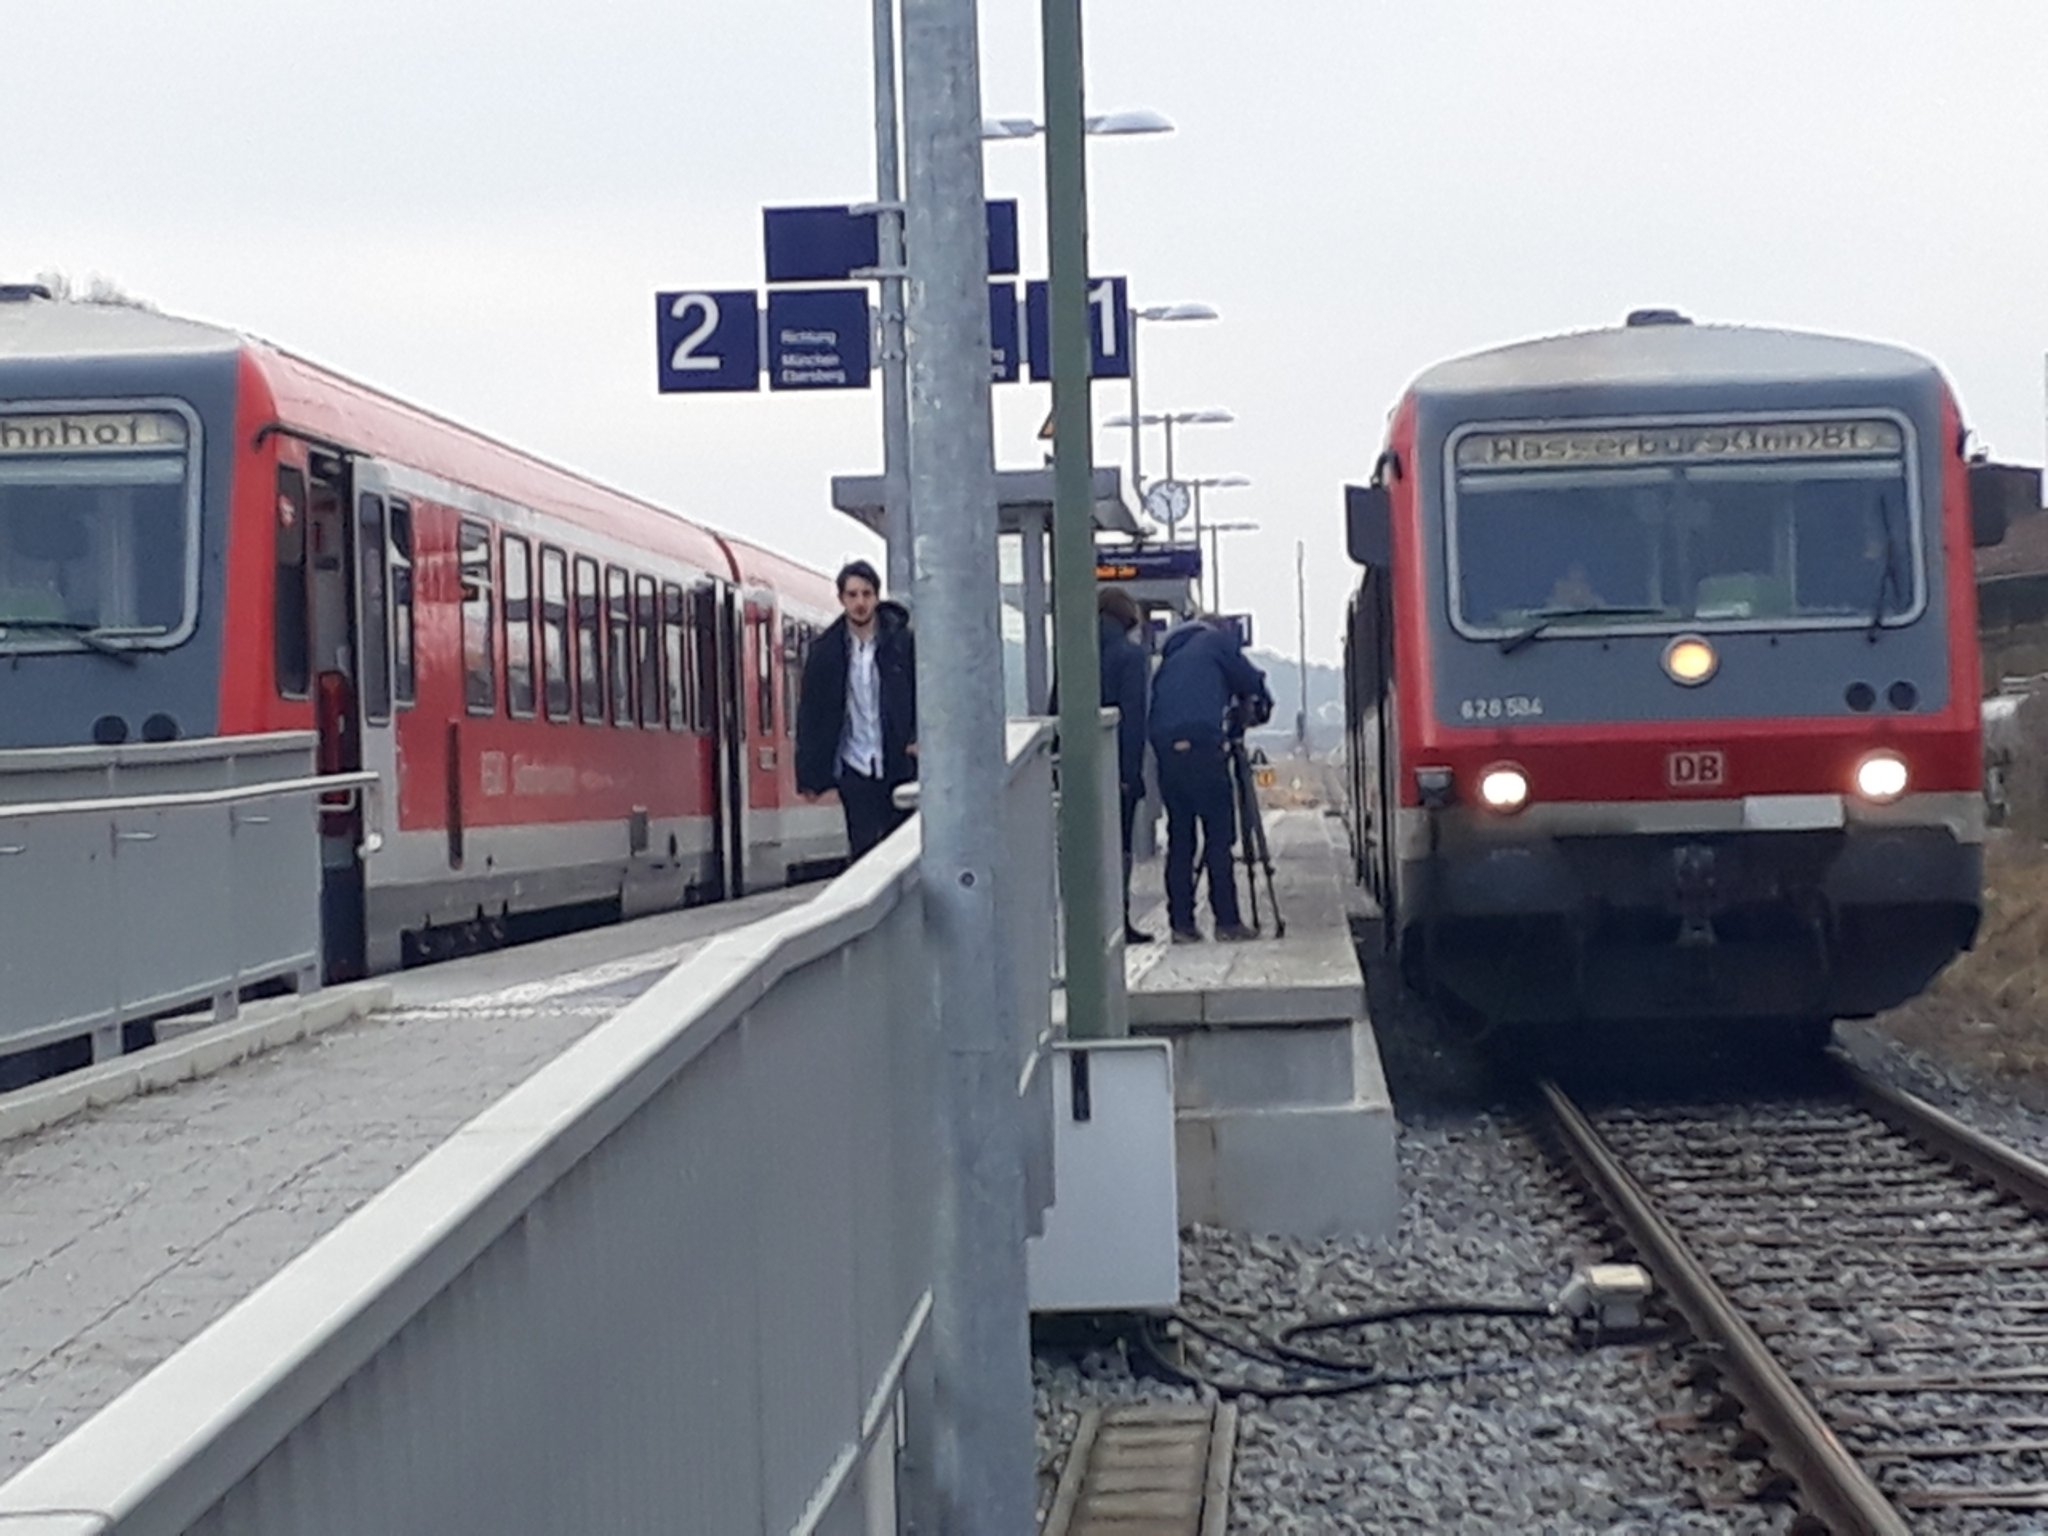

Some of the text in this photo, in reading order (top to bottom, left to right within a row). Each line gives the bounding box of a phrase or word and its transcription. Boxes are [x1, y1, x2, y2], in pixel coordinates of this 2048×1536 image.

[1088, 279, 1115, 357] 1
[671, 293, 720, 370] 2
[781, 353, 840, 368] München
[782, 369, 846, 384] Ebersberg
[1460, 698, 1502, 719] 628
[1674, 754, 1721, 785] DB
